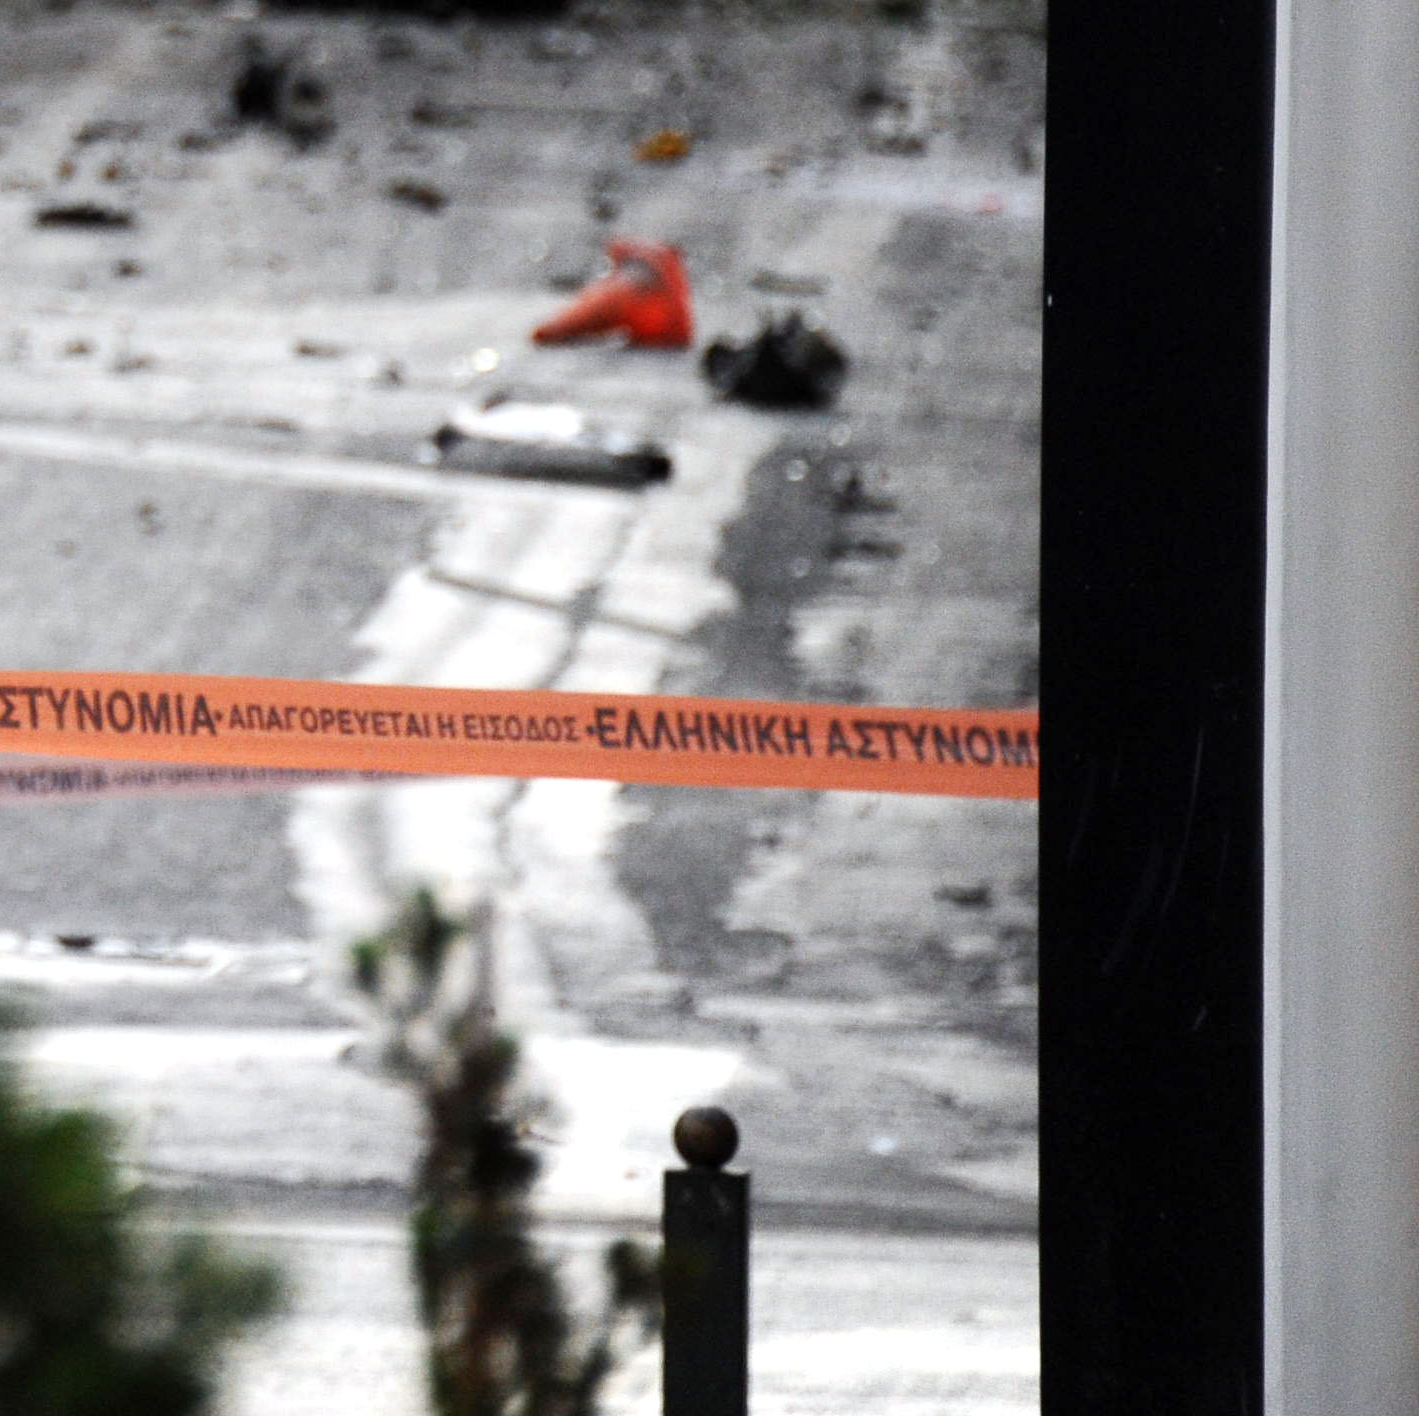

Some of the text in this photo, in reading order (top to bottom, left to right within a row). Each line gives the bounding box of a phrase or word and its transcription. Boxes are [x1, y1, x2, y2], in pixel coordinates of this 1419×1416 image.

[228, 704, 431, 737] ΑΠΑΓΟΡΕΥΕΤΑΙ
[464, 714, 579, 743] ΕΙΣΟΔΟΣ
[595, 706, 812, 756] ΕΛΛΗΝΙΚΗ
